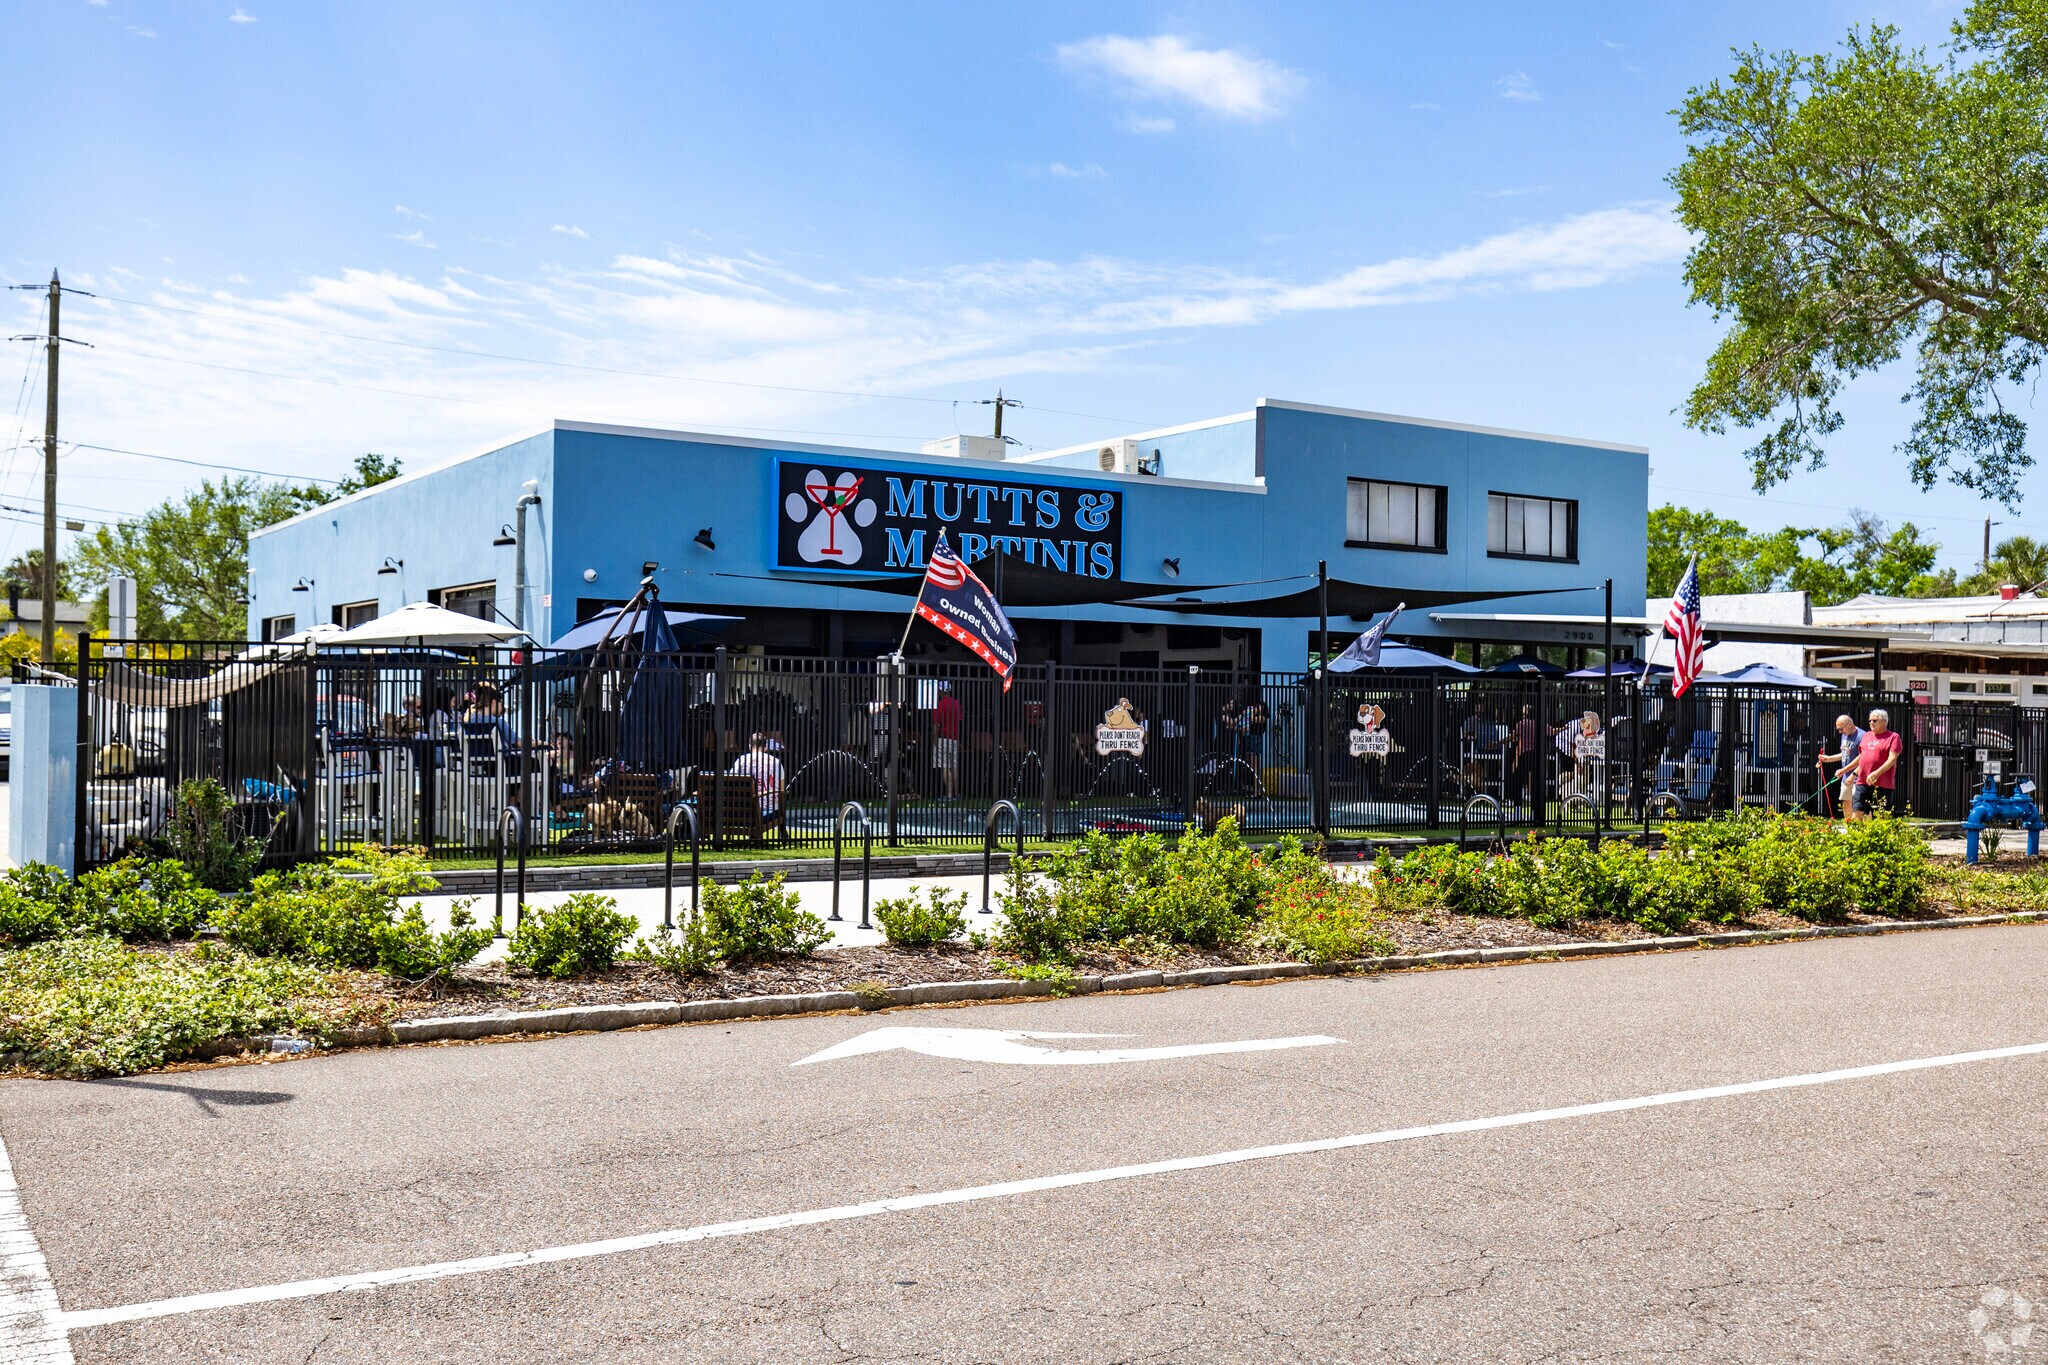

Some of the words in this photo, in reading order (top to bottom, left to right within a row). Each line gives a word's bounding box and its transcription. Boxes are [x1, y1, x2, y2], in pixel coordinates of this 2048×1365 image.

[884, 477, 1061, 529] MUTTS
[1074, 492, 1115, 532] &
[884, 527, 1114, 580] MRTINIS
[940, 598, 981, 629] Owned
[974, 594, 1001, 635] Woman
[1564, 631, 1594, 640] 2900
[1099, 730, 1113, 740] PLEASE
[1126, 730, 1140, 740] REACH
[1352, 735, 1364, 743] PLEASE
[1375, 735, 1386, 743] REACH
[1100, 740, 1117, 749] THRU
[1119, 740, 1139, 749] FENCE
[1354, 743, 1368, 751] THRU
[1369, 743, 1386, 751] FENCE
[1590, 746, 1604, 755] FENCE
[1928, 759, 1937, 767] EXIT
[1926, 767, 1938, 775] ONLY
